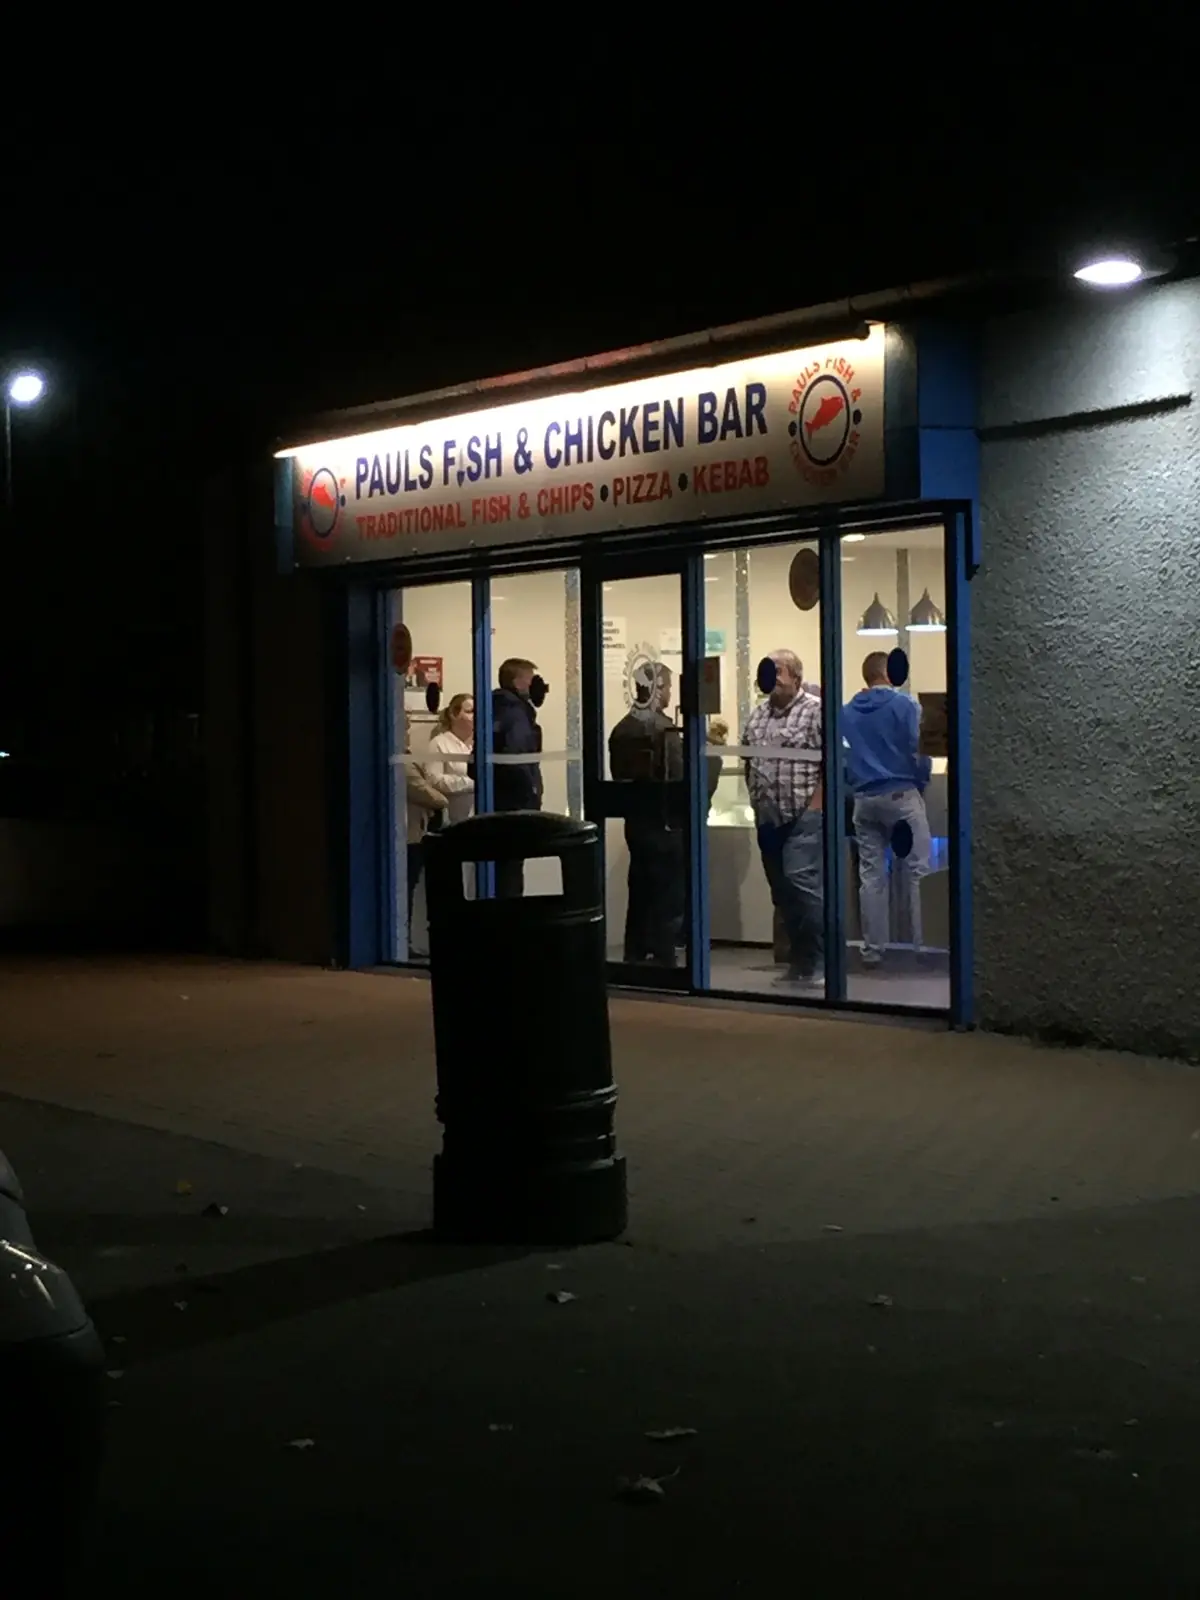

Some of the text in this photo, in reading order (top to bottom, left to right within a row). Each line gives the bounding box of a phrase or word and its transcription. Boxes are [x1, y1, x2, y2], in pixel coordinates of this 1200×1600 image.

[356, 444, 434, 500] PAULS
[514, 427, 533, 475] &
[544, 397, 685, 469] CHICKEN
[698, 382, 768, 445] BAR
[355, 502, 467, 541] TRADITIONAL
[471, 494, 512, 526] FISH
[517, 492, 531, 519] &
[537, 482, 595, 516] CHIPS
[613, 469, 673, 507] PIZZA
[692, 456, 770, 496] KEBAB
